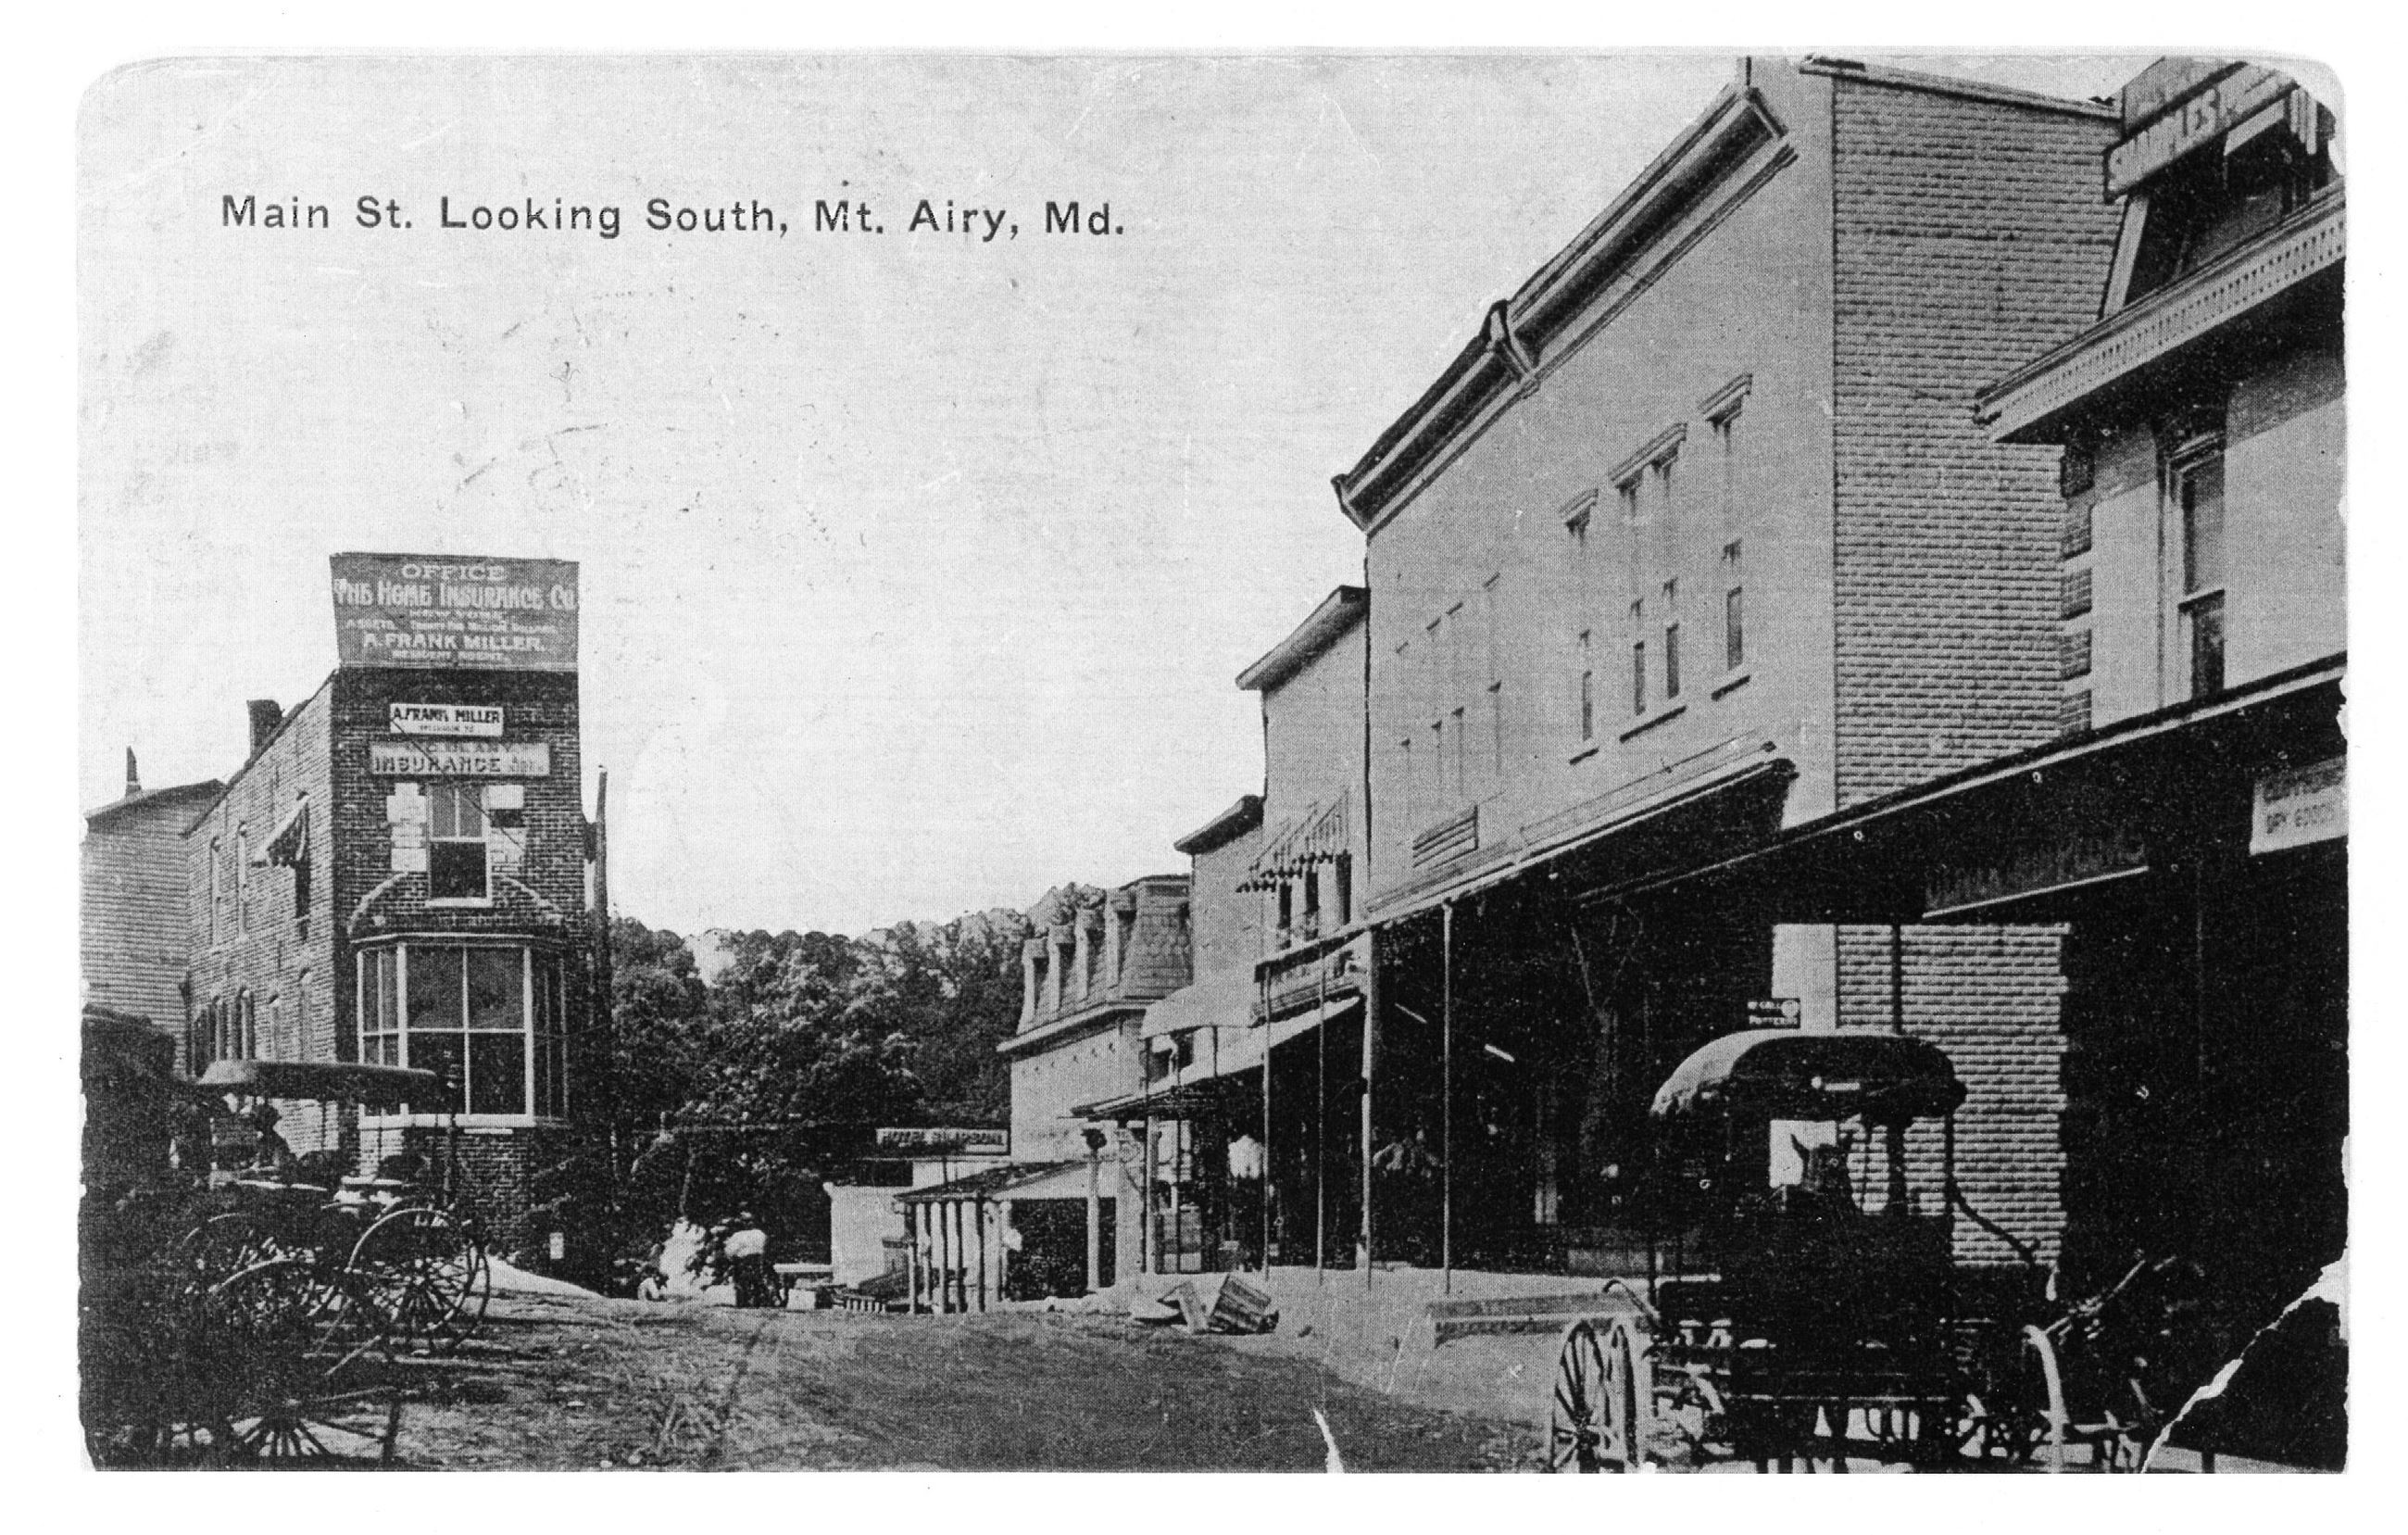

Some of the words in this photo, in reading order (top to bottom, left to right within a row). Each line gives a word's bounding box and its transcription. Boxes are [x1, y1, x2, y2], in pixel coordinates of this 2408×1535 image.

[401, 563, 505, 582] OFFICE
[377, 579, 433, 607] HOME
[440, 583, 545, 611] INSURANCE
[455, 710, 501, 724] MILLER
[373, 755, 502, 774] INSURANCE
